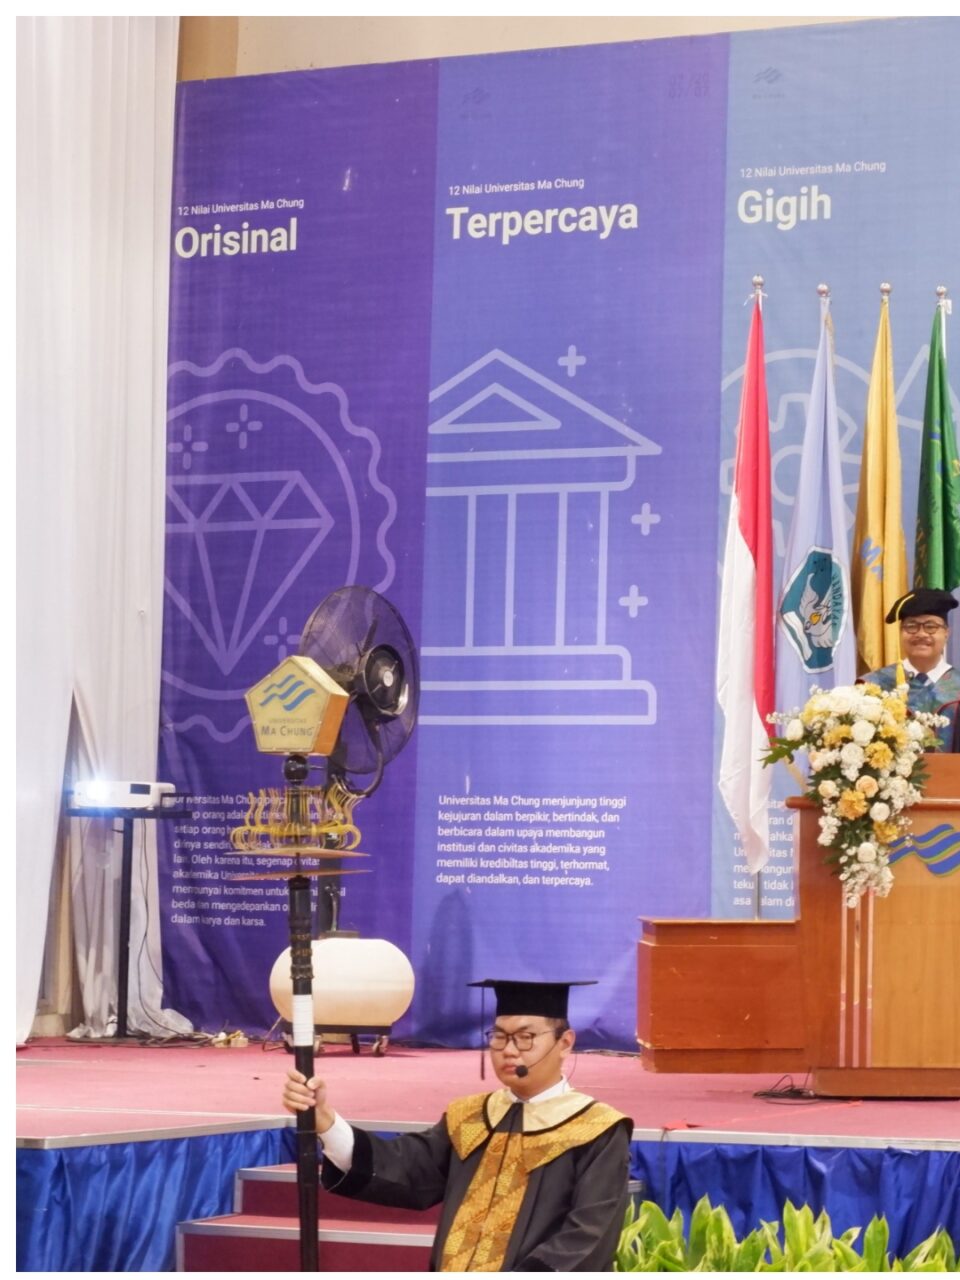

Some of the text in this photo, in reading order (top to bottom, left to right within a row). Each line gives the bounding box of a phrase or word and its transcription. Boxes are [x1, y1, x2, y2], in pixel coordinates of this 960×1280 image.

[740, 159, 886, 178] 12 Nilai Universitas Ma Chung
[449, 177, 584, 195] 12 Nilai Universitas Ma Chung
[177, 197, 304, 215] 12 Nilai Universitas Ma Chung
[737, 186, 832, 230] Gigih
[446, 200, 639, 245] Terpercaya
[174, 218, 298, 258] Orisinal
[438, 795, 626, 809] Universitas Ma Chung menjunjung tinggi
[438, 811, 620, 823] kejujuran dalam berpikir, bertindak, dan
[437, 826, 605, 840] berbicara dalam upaya membangun
[436, 841, 606, 857] institusi dan civitas akademika yang
[436, 857, 478, 867] memiliki
[529, 859, 558, 872] tinggi,
[560, 860, 609, 870] terhormat,
[435, 873, 593, 887] dapat diandalkan, dan terpercaya.
